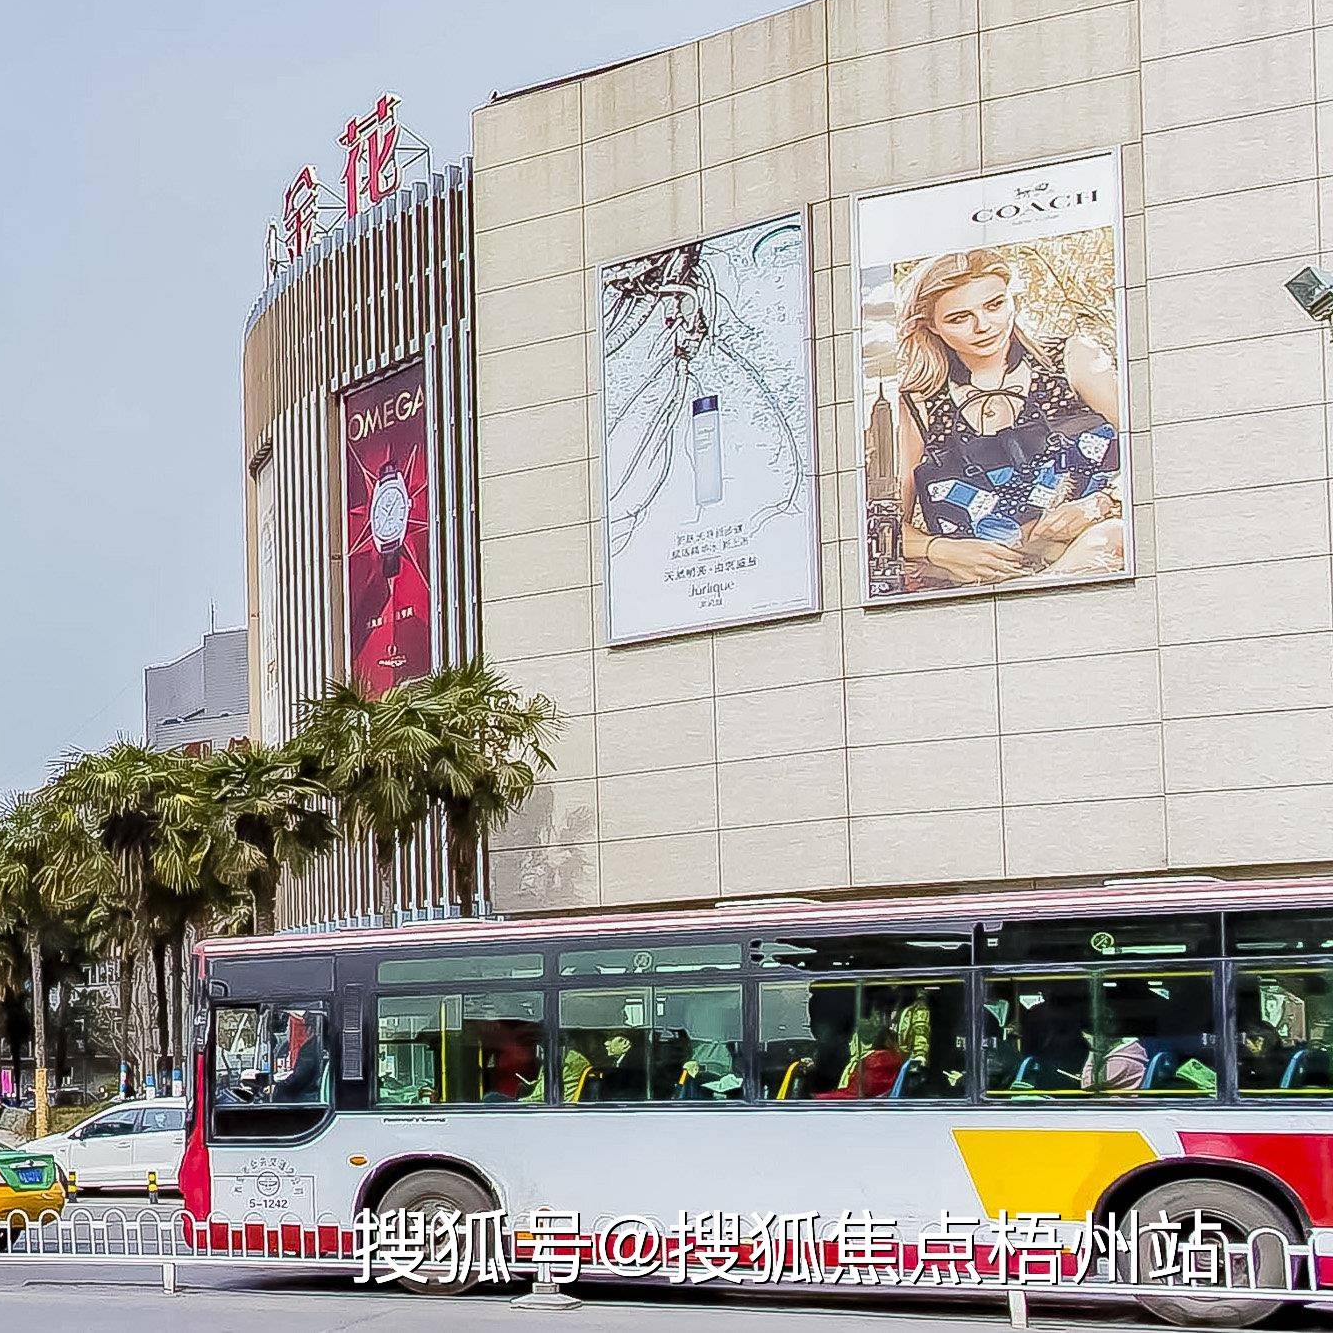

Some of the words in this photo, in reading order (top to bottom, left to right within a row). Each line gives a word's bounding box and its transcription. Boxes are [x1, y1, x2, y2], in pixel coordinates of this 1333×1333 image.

[971, 190, 1098, 223] COACH
[348, 385, 425, 442] OMEGA
[249, 1198, 289, 1209] 5-1242
